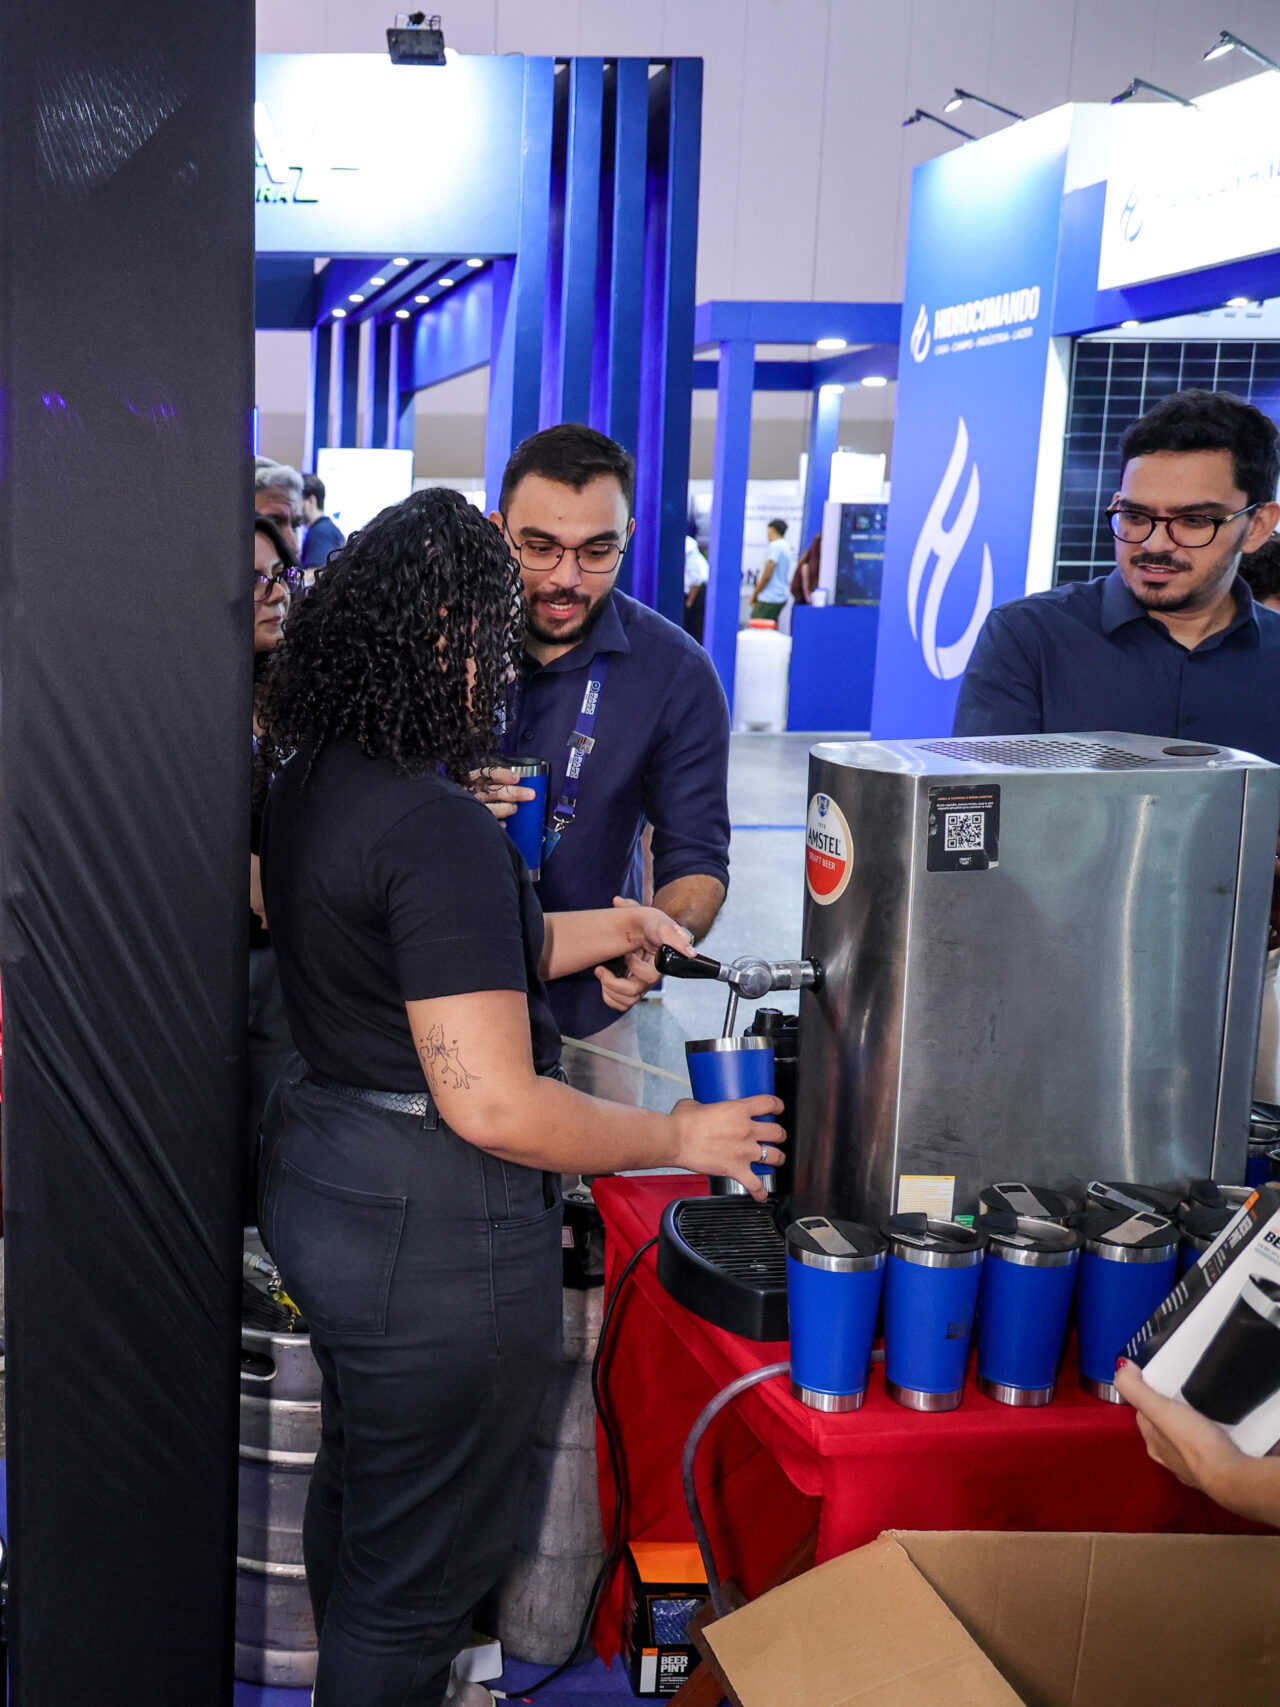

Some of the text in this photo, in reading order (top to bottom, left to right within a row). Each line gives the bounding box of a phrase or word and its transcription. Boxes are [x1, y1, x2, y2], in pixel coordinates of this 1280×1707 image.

[933, 285, 1040, 341] HIDROCOMANDO
[808, 827, 841, 856] AMSTEL
[822, 858, 836, 871] BEER
[660, 1655, 689, 1665] BEER
[660, 1664, 688, 1673] PINT
